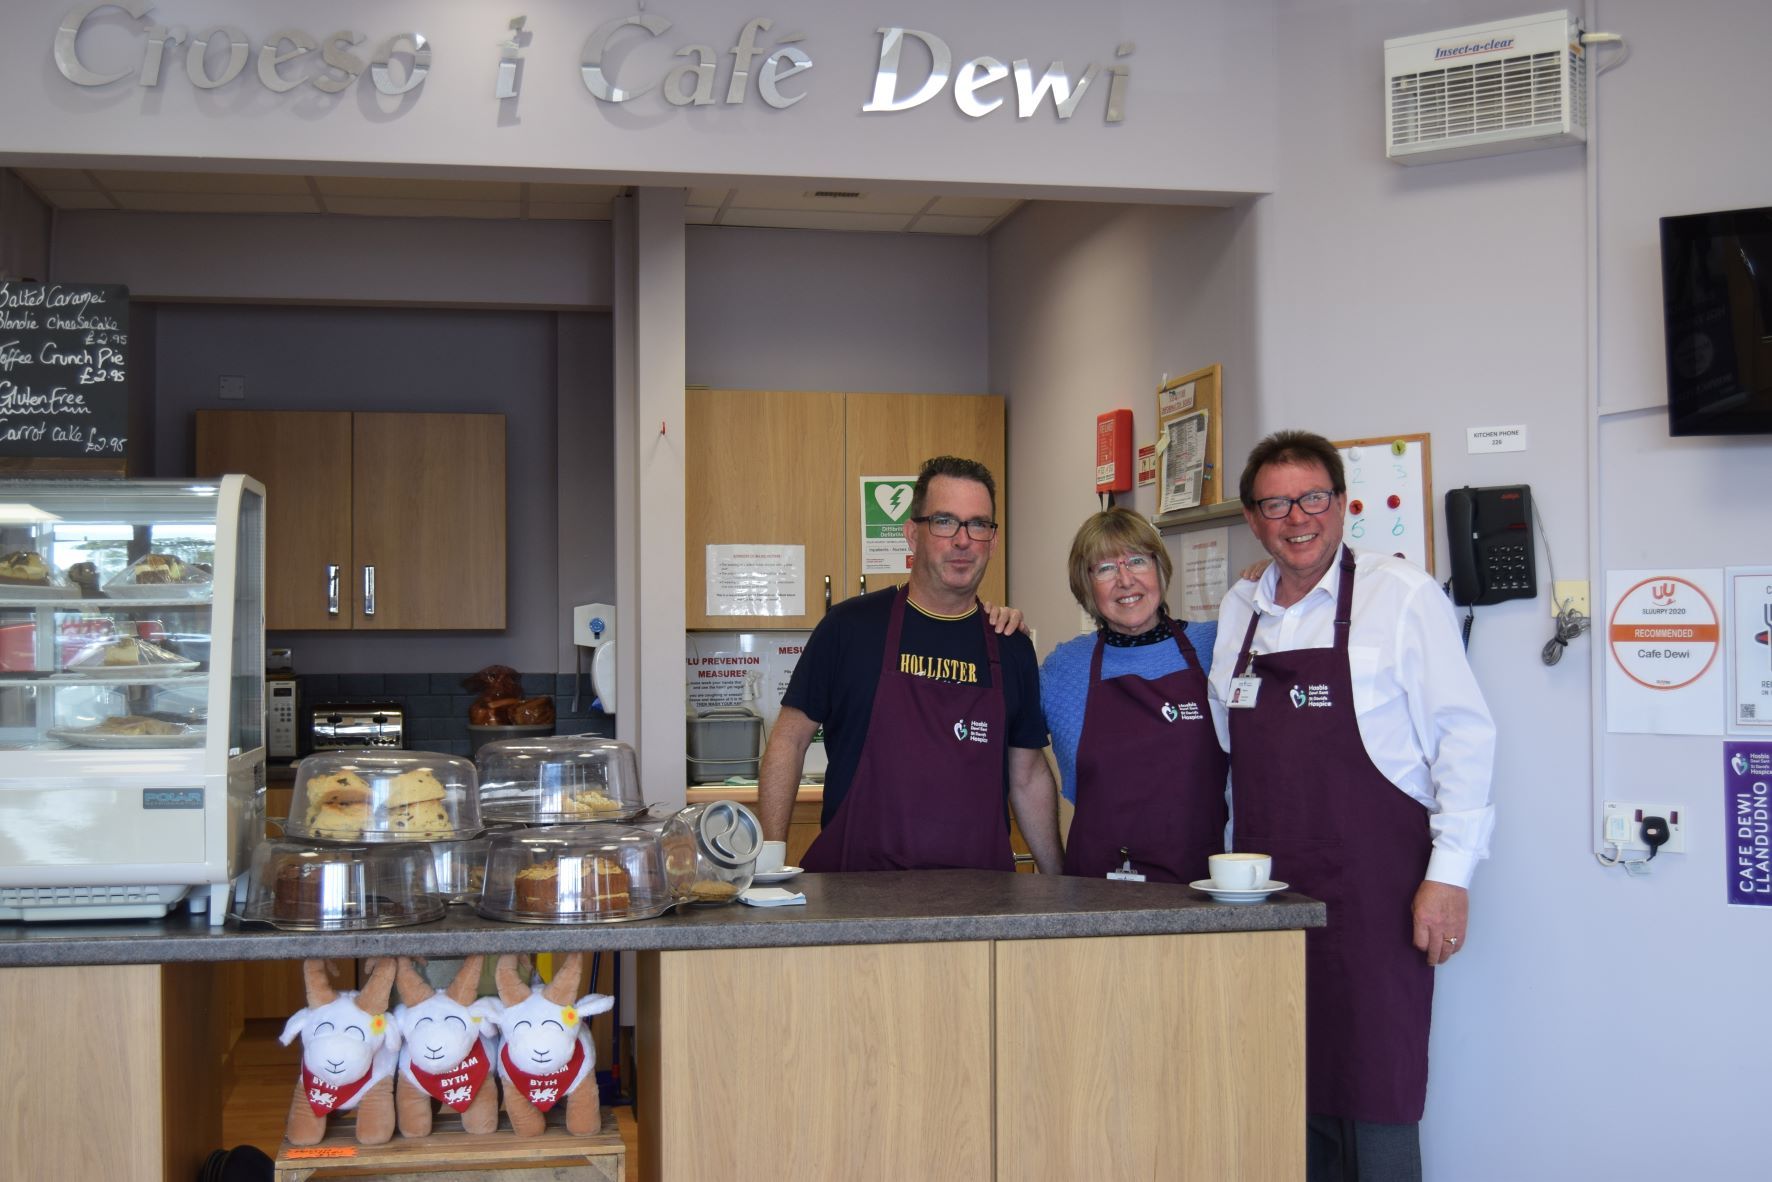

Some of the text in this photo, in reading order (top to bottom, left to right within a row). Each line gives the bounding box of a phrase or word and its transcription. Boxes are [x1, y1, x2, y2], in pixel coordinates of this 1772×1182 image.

[1435, 37, 1514, 59] Insect-a-clear
[54, 0, 1135, 122] Croeso i Café Dewi
[86, 331, 127, 345] £2.95
[40, 342, 92, 365] Crunch
[99, 348, 124, 368] Pie
[80, 368, 125, 384] £2.95
[1392, 517, 1404, 536] 6
[1634, 629, 1693, 638] RECOMMENDED
[702, 657, 760, 666] PREVENTION
[1637, 649, 1690, 659] Cafe Dewi
[901, 653, 977, 683] HOLLISTER
[1737, 793, 1754, 893] CAFE DEWI
[1753, 782, 1770, 893] LLANDUDNO
[441, 1073, 469, 1087] BYTH
[530, 1079, 558, 1087] BYTH
